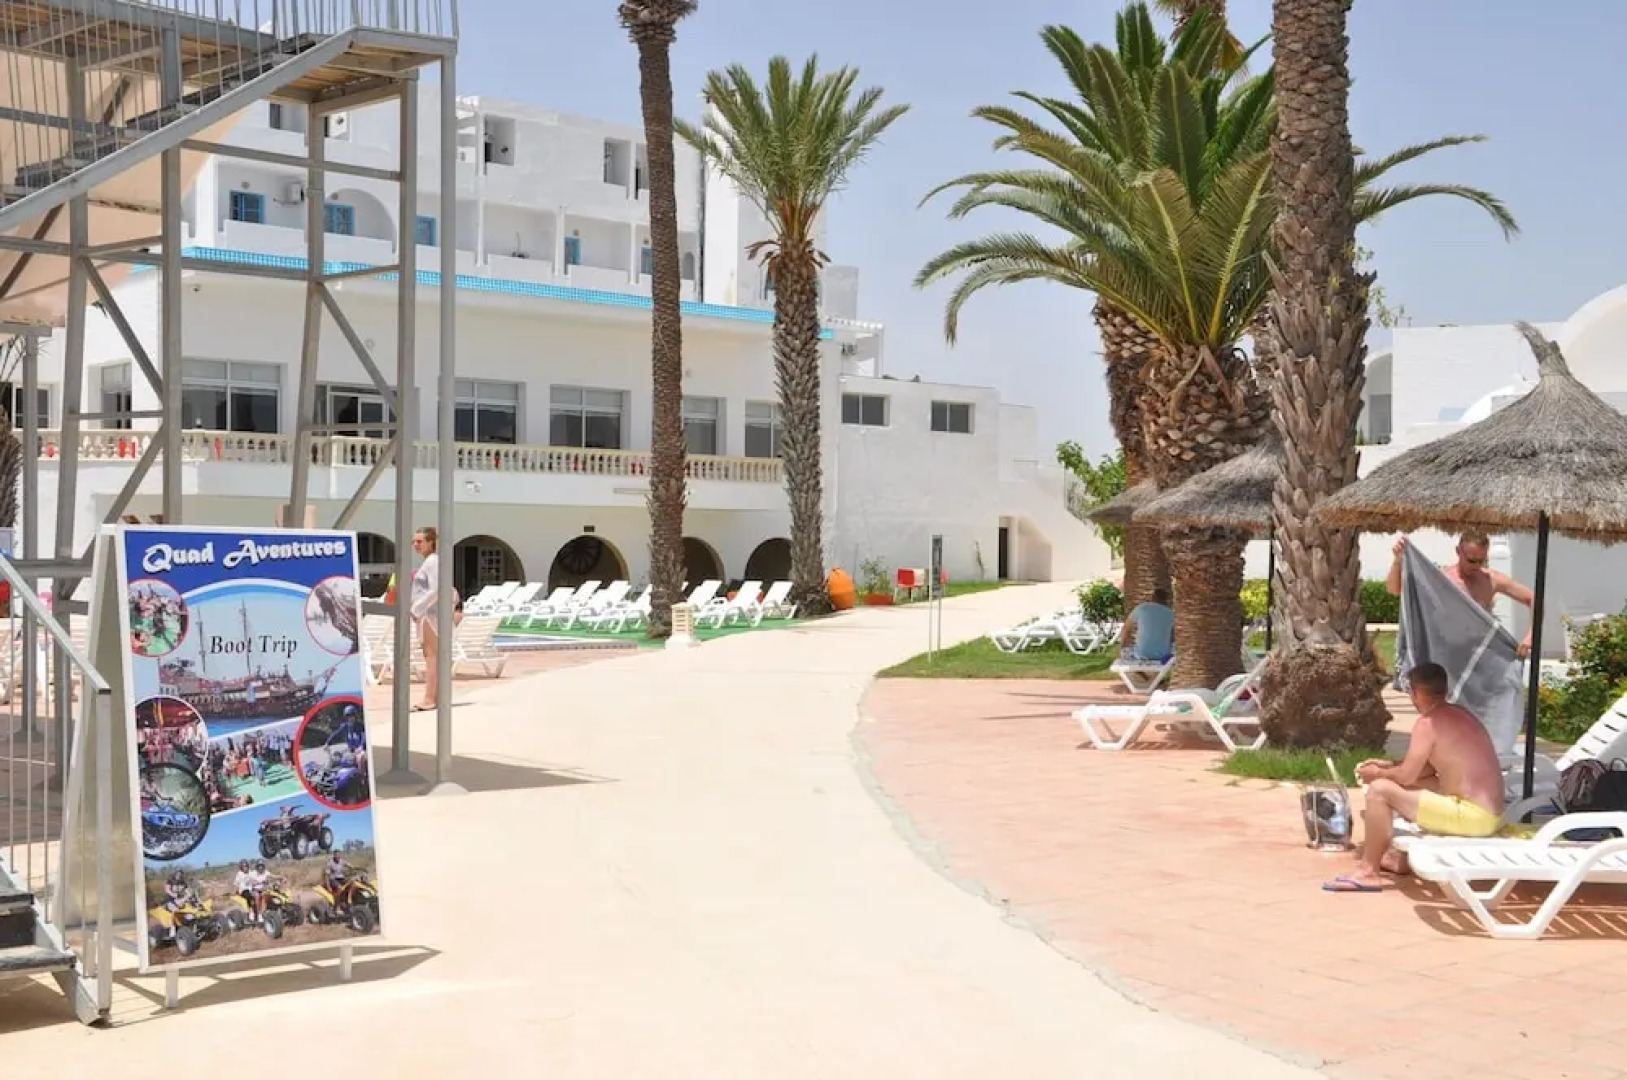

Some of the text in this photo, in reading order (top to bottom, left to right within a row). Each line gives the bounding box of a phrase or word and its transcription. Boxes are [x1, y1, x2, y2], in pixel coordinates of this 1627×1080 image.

[142, 539, 347, 573] Quad Aventures
[258, 635, 298, 658] Trip
